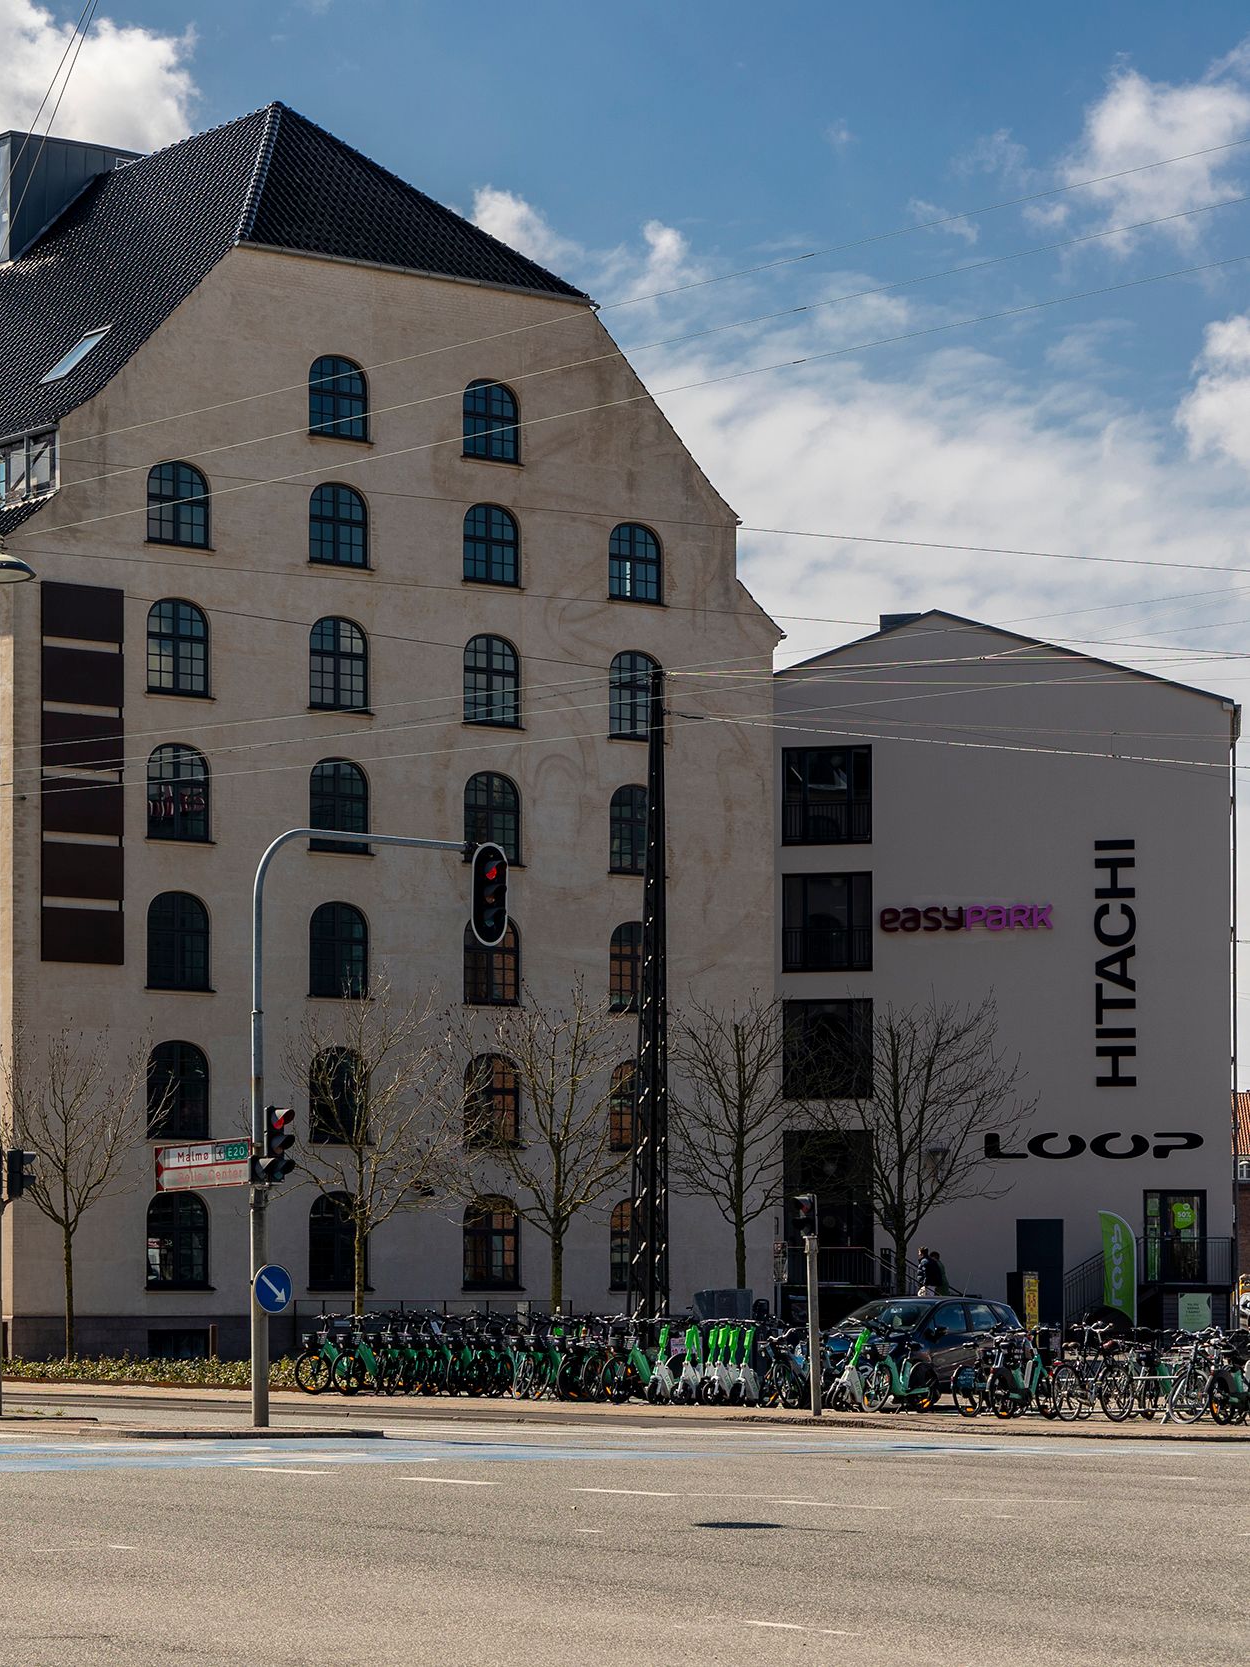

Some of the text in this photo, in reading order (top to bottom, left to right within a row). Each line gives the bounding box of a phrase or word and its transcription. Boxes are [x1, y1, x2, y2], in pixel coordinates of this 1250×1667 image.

[1094, 839, 1137, 1087] HITACHI
[177, 1146, 245, 1163] Malmø E20
[984, 1132, 1204, 1159] LOOP
